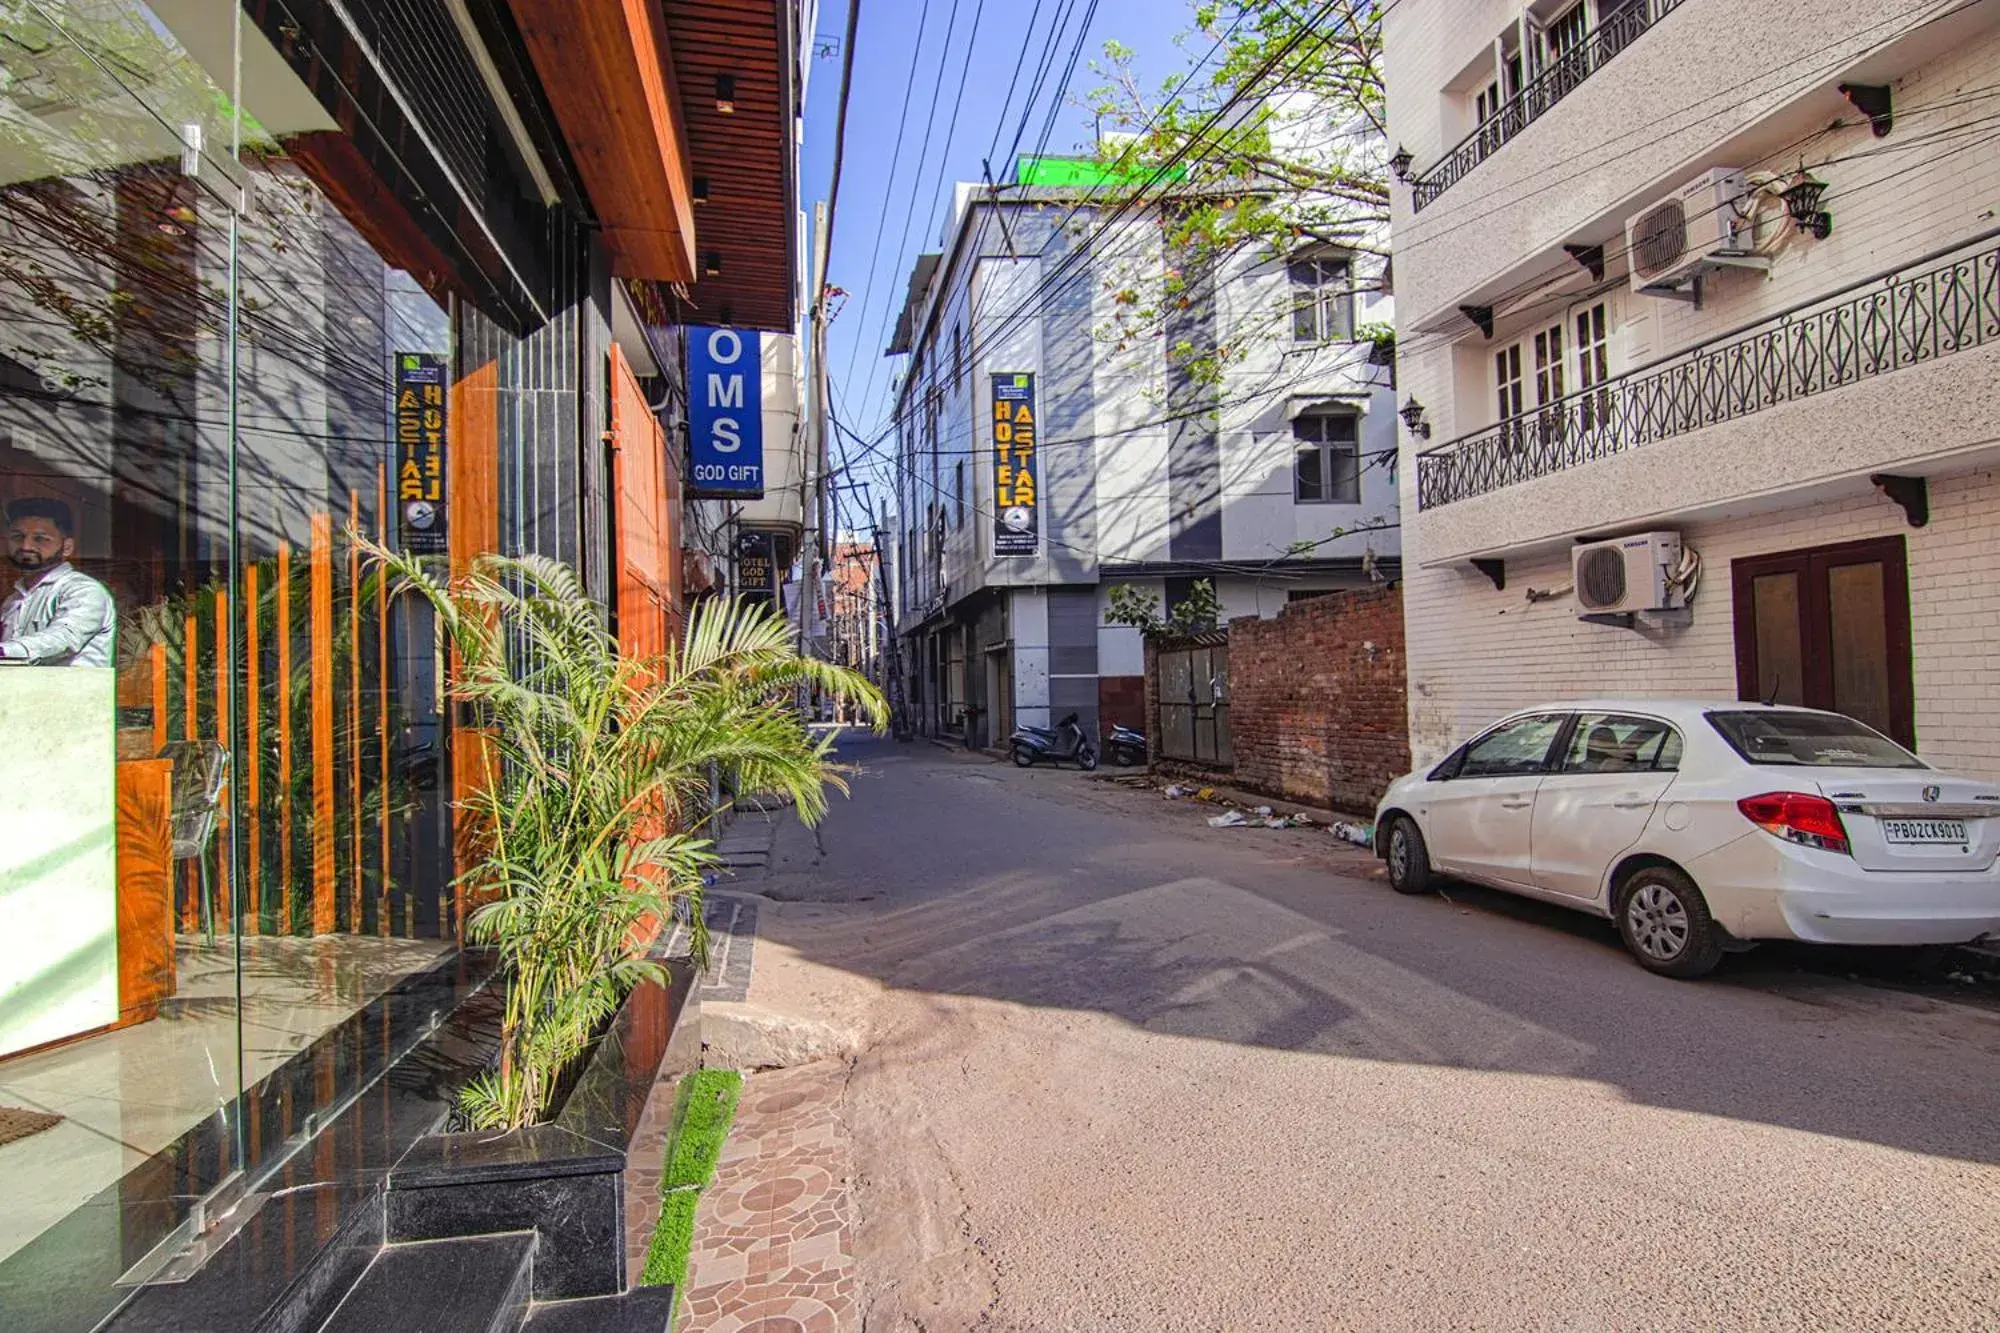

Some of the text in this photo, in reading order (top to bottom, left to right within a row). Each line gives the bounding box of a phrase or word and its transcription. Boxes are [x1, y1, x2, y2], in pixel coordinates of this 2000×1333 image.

[995, 401, 1012, 506] HOTEL
[695, 465, 759, 481] GOD GIFT
[743, 567, 764, 577] GOD
[741, 576, 766, 587] GIFT
[1893, 823, 1965, 838] PB02CK9013
